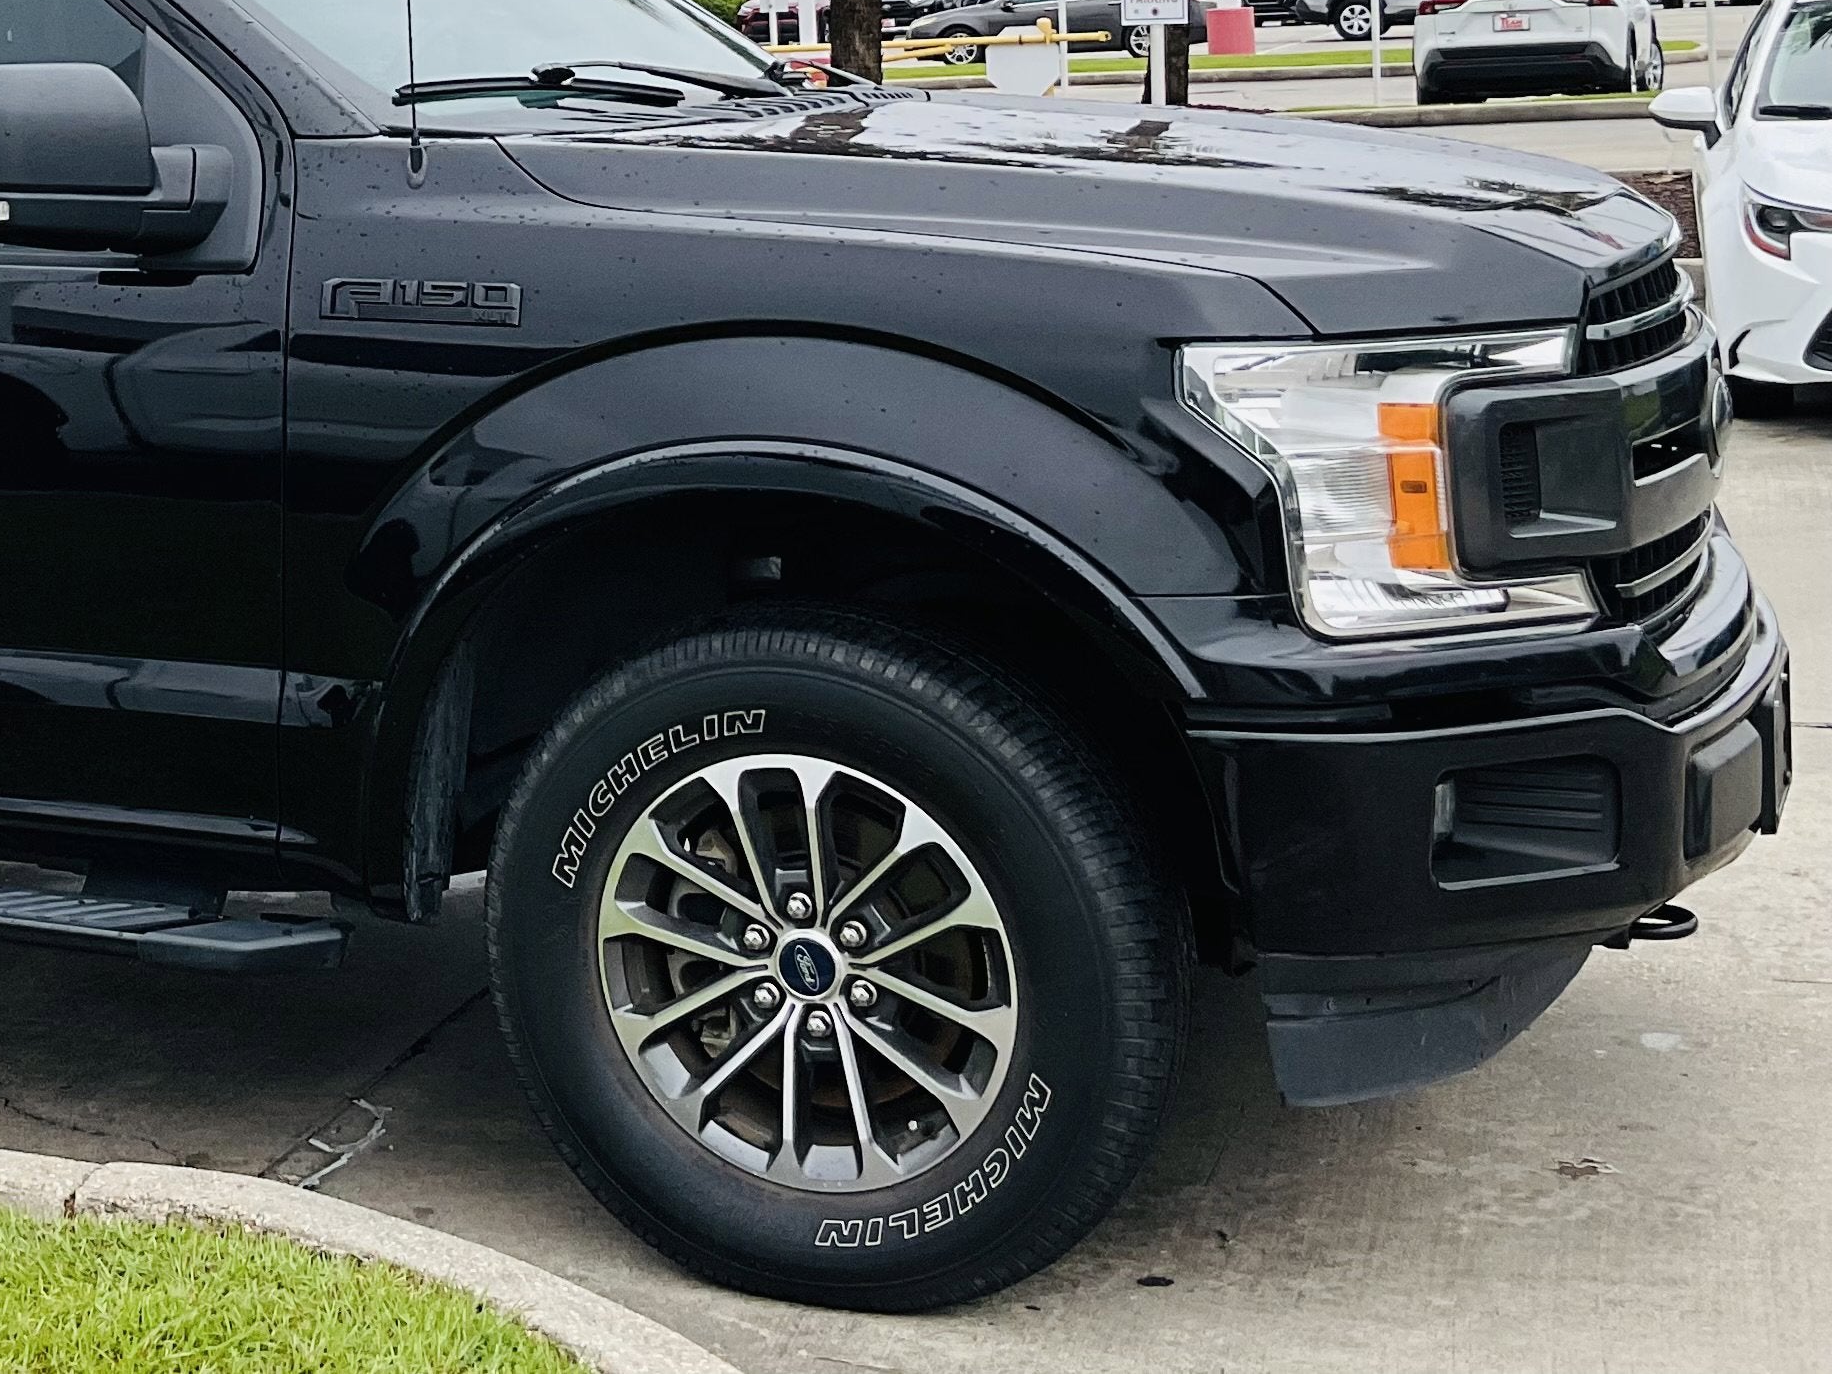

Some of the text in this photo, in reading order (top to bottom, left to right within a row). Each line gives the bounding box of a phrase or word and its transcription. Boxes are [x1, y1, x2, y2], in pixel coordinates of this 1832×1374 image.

[474, 310, 514, 323] XLT
[551, 708, 767, 889] MICHELIN
[796, 954, 816, 983] Ford
[814, 1072, 1053, 1248] MICHELIN
